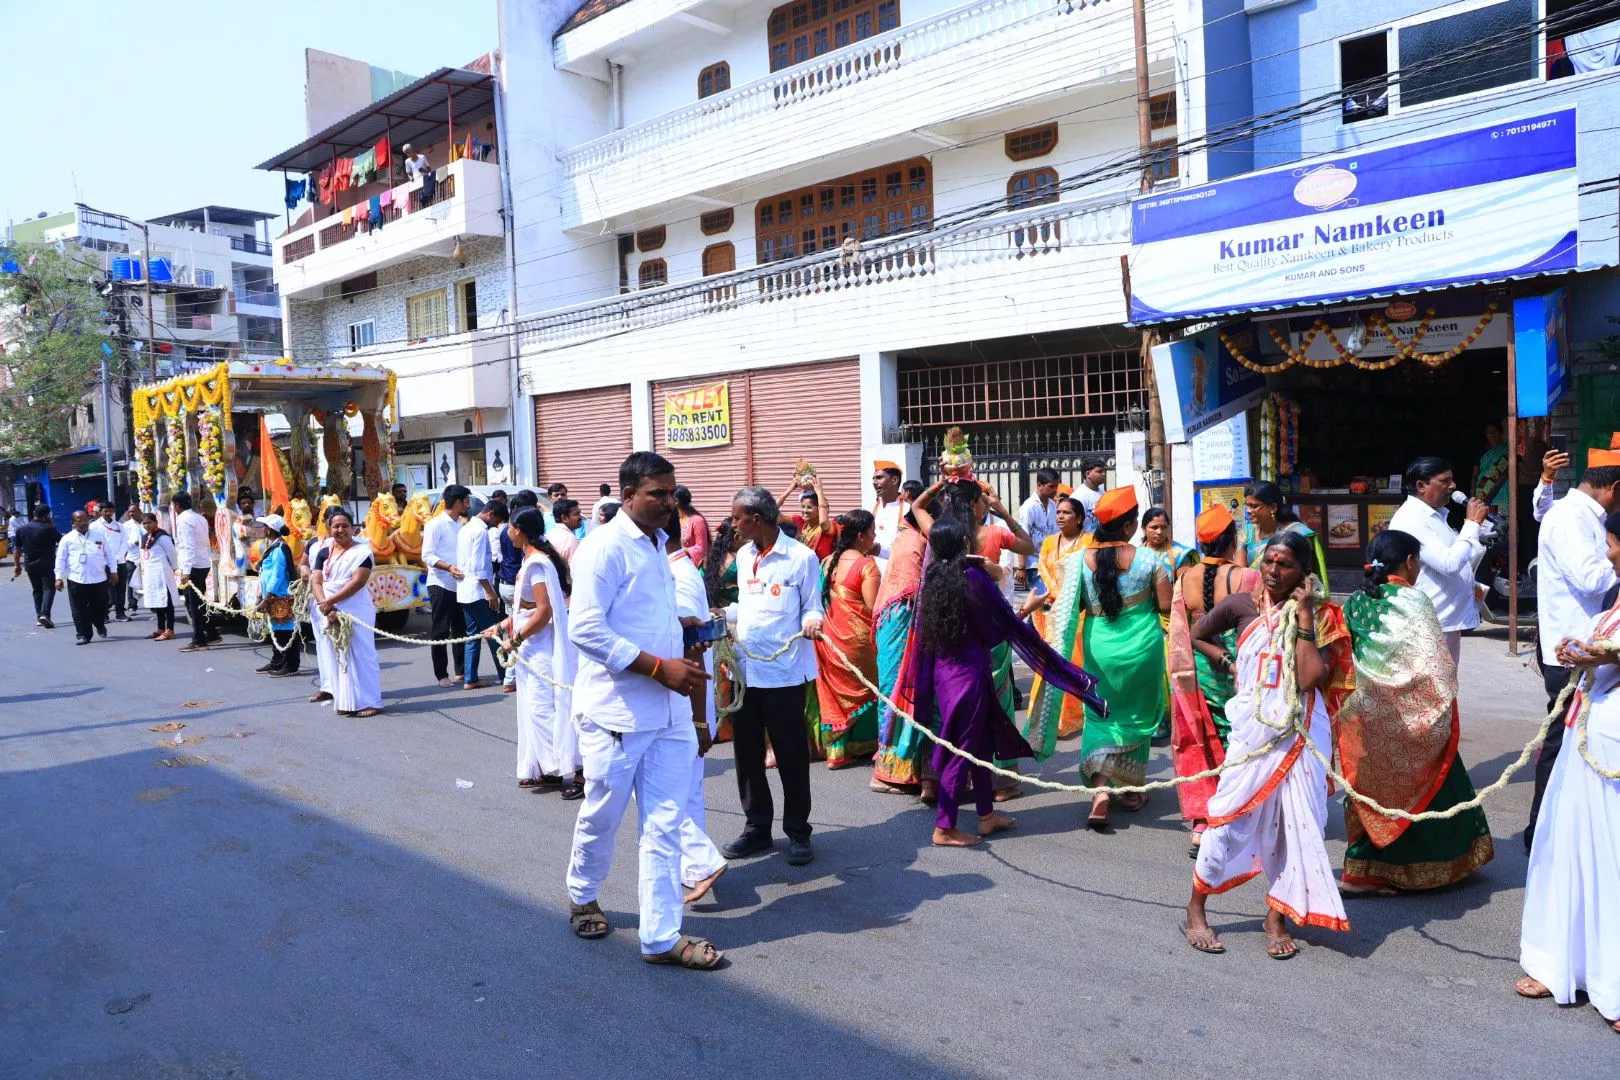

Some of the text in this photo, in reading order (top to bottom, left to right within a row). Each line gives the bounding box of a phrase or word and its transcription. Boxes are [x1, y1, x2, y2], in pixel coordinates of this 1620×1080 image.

[1505, 118, 1557, 136] 7013194971
[1219, 208, 1446, 260] Kumar Namkeen
[1212, 227, 1455, 274] Best Quality Namkeen & Bakery Products
[1285, 270, 1317, 283] KUMAR
[1317, 266, 1339, 280] AND
[1339, 263, 1366, 277] SONS
[692, 385, 724, 410] LET
[692, 410, 723, 424] RENT
[1186, 421, 1203, 435] KUMAR
